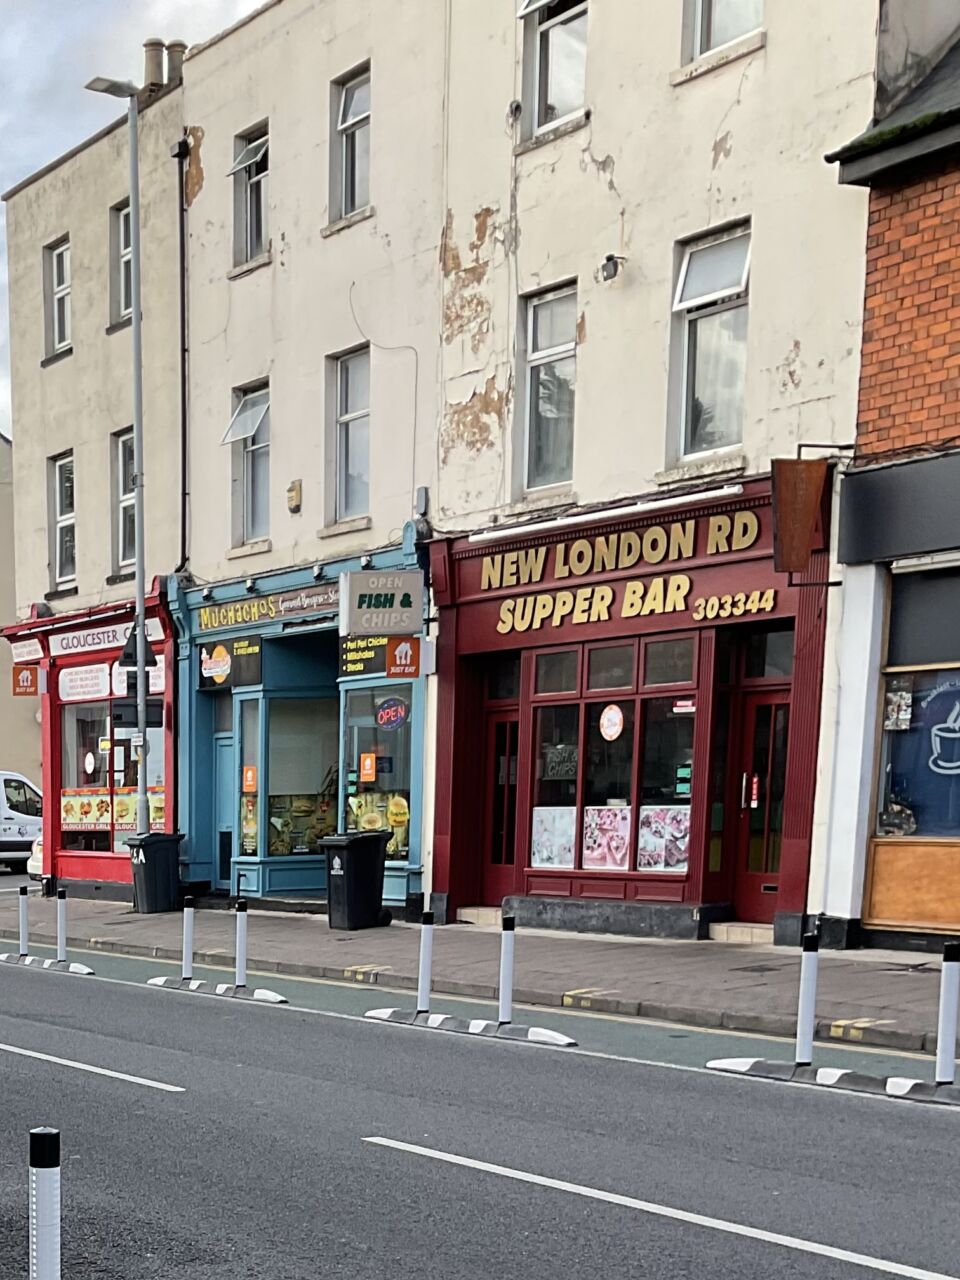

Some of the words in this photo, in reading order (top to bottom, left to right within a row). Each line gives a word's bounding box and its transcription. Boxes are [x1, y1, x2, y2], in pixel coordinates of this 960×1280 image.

[480, 547, 547, 590] NEW
[554, 520, 695, 579] LONDON
[707, 510, 758, 554] RD
[368, 577, 403, 588] OPEN
[357, 593, 395, 609] FISH
[400, 592, 412, 608] &
[496, 585, 613, 634] SUPPER
[620, 574, 691, 618] BAR
[692, 588, 775, 621] 303344
[361, 612, 410, 628] CHIPS
[60, 629, 119, 650] GLOUCESTER
[390, 666, 404, 674] JUST
[377, 704, 406, 725] OPEN
[548, 762, 576, 776] CHIPS
